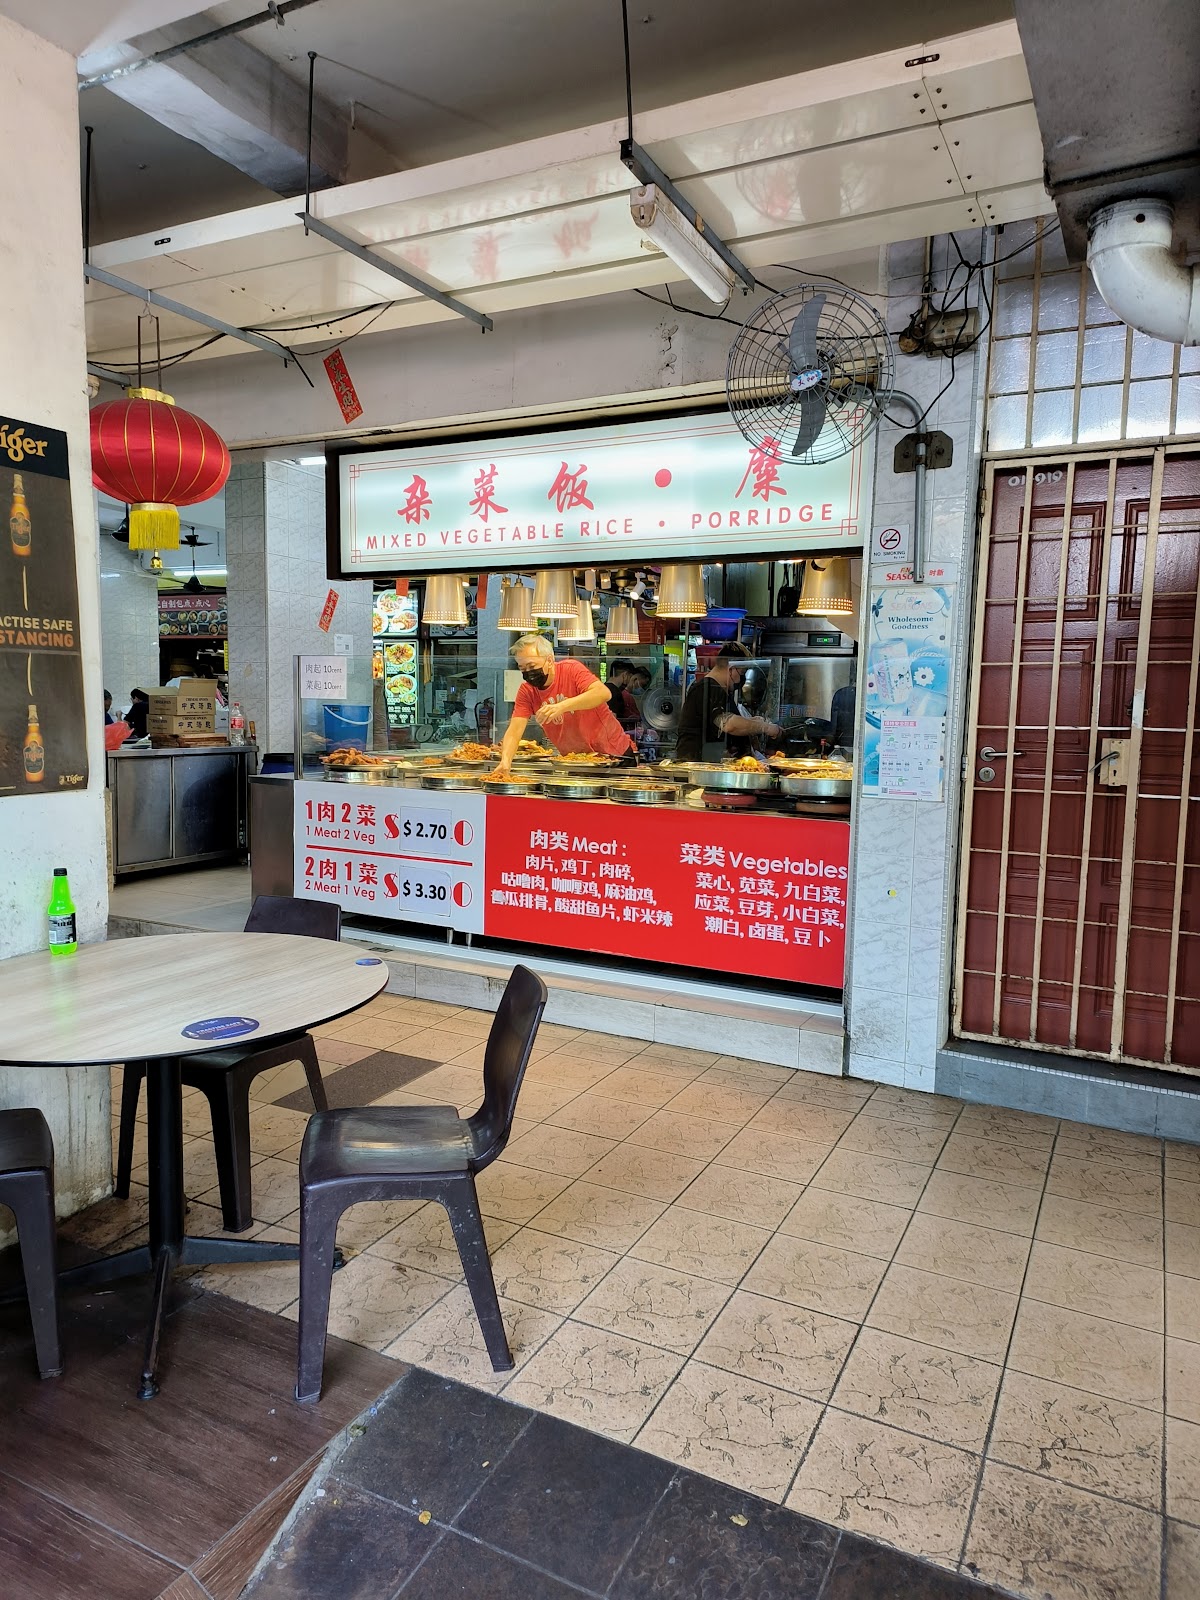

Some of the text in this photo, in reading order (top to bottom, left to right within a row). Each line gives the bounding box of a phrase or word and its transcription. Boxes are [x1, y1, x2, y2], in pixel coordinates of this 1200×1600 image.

[366, 503, 832, 549] MIXED VEGETABLE RICE PORRIDGE
[43, 619, 73, 631] SAFE
[888, 615, 934, 623] Wholesome
[66, 774, 84, 784] Tiger
[306, 825, 375, 845] 1 Meat 2 Veg
[530, 829, 568, 851] 肉类
[679, 842, 848, 880] 菜类 Vegetables
[305, 880, 375, 901] 2 Meat 1 Veg
